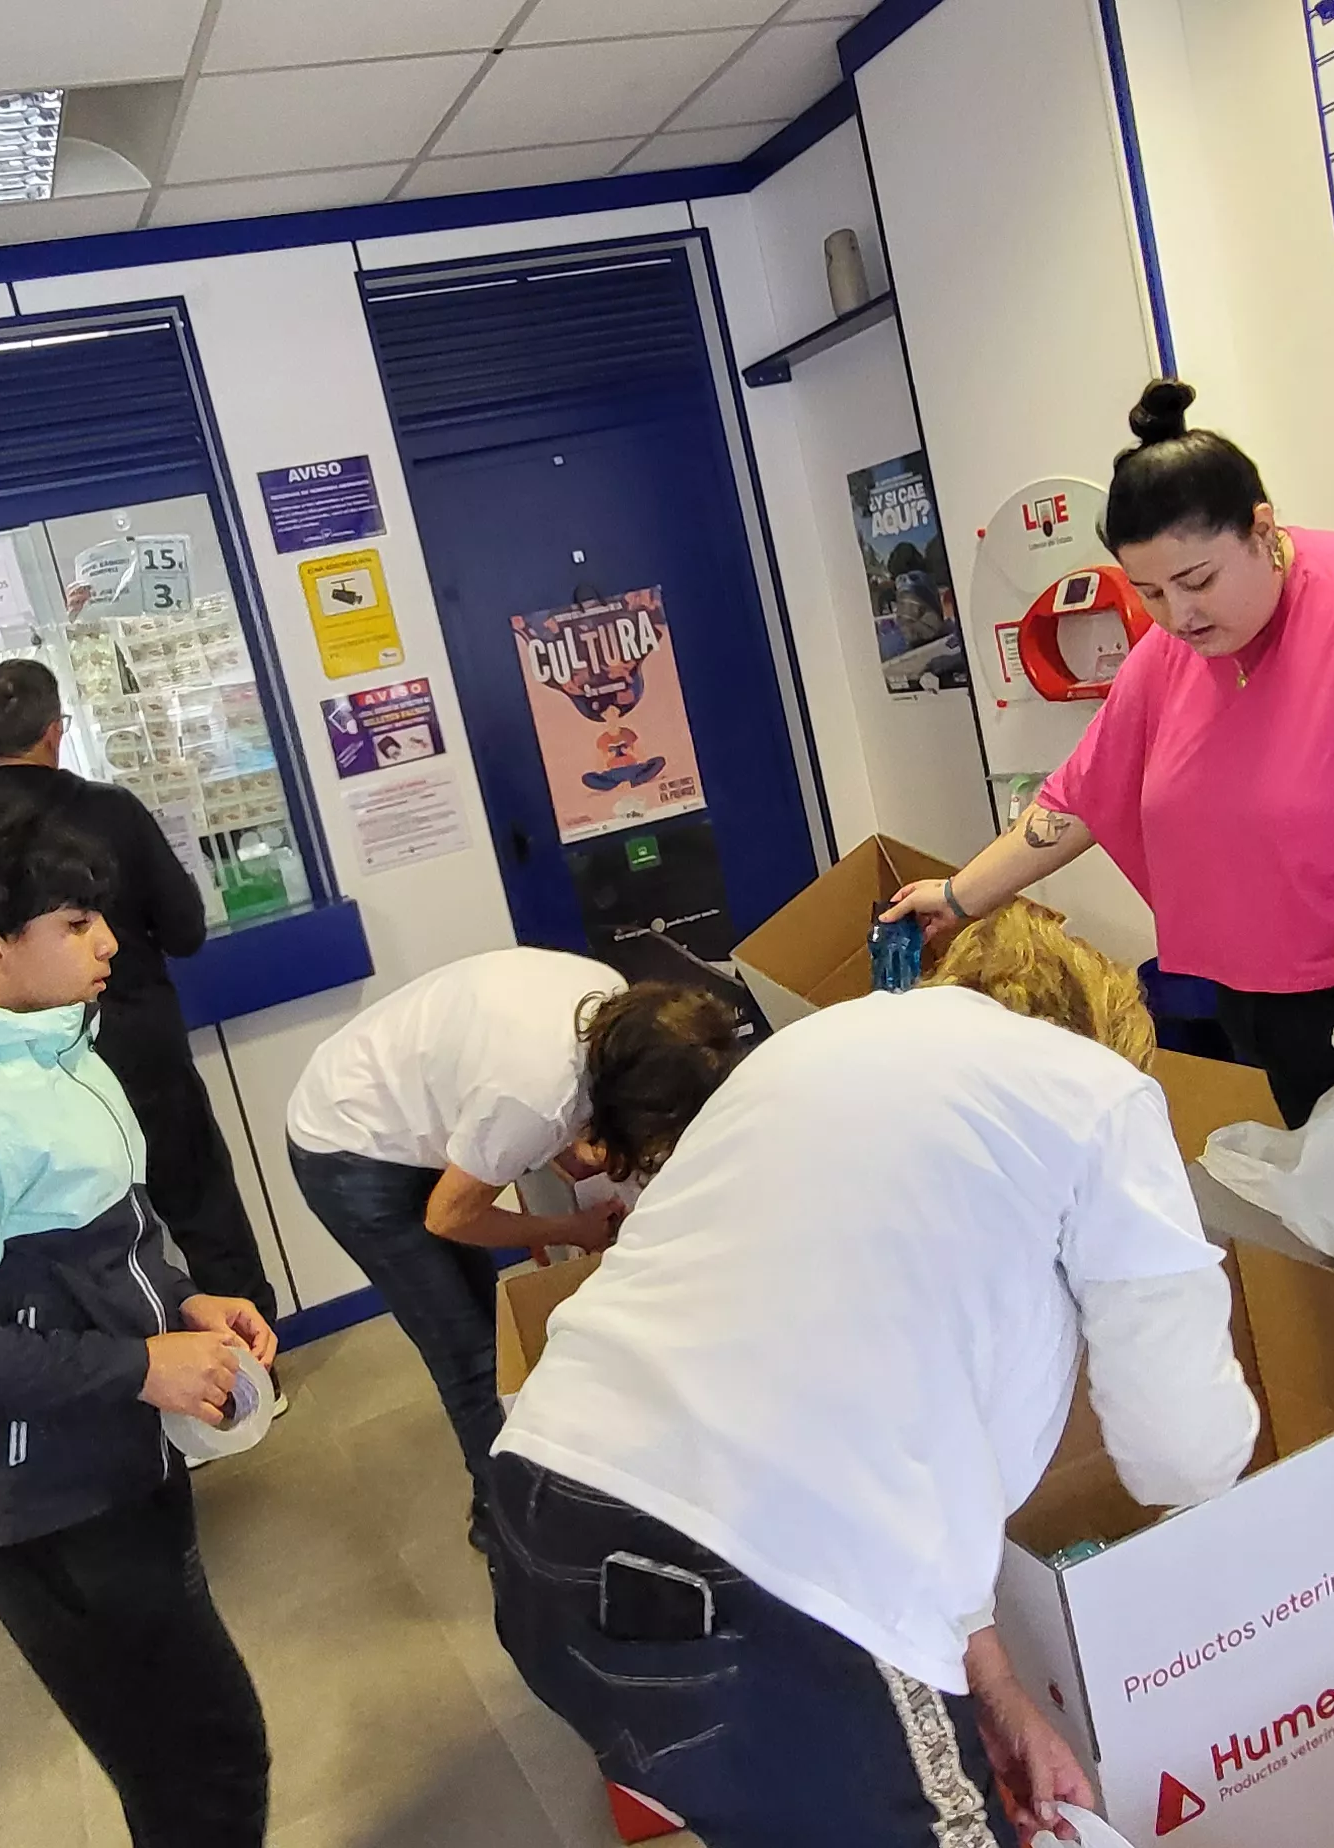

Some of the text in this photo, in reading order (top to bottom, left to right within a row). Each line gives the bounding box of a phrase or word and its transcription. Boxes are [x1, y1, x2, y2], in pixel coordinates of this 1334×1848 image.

[288, 462, 342, 483] AVISO
[898, 483, 926, 505] CAE
[528, 610, 660, 685] CULTURA
[365, 683, 421, 704] AVISO
[1123, 1620, 1257, 1703] Productos
[1219, 1755, 1288, 1802] Productos
